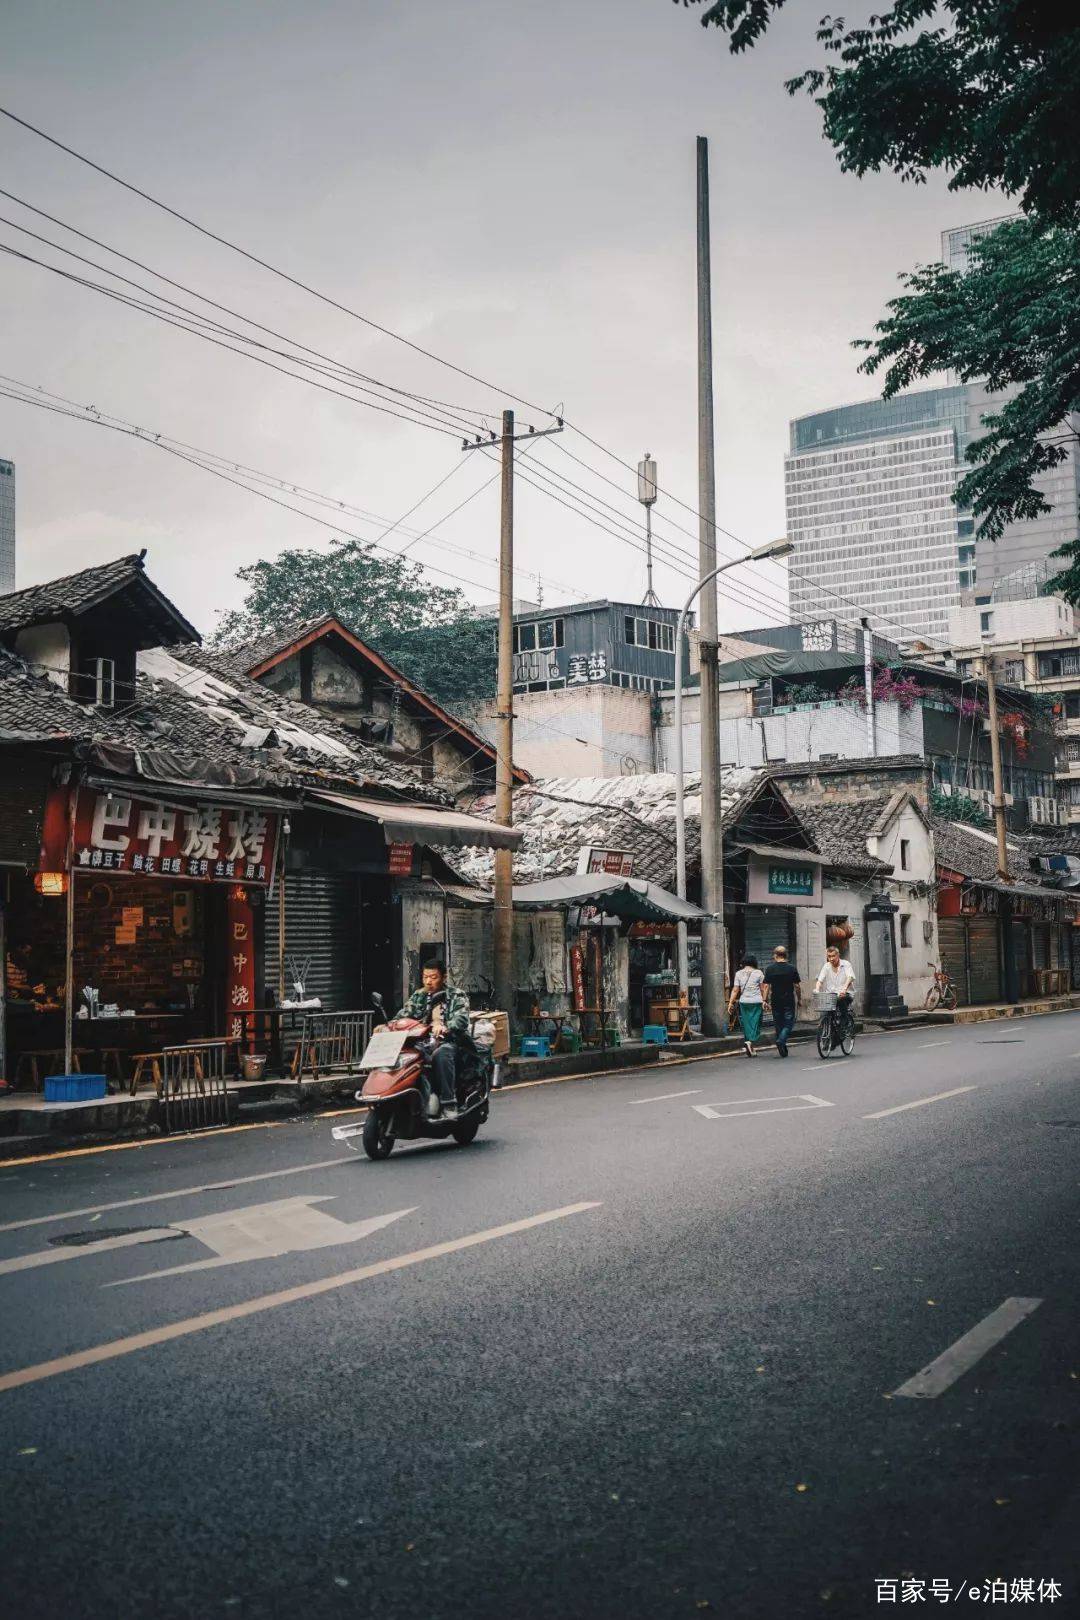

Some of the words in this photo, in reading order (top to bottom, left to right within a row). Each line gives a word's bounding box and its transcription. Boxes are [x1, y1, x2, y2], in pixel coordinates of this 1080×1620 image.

[91, 797, 268, 864] 巴中烧烤
[161, 858, 182, 873] 田螺
[189, 859, 209, 875] 花甲
[246, 864, 266, 880] 扇贝
